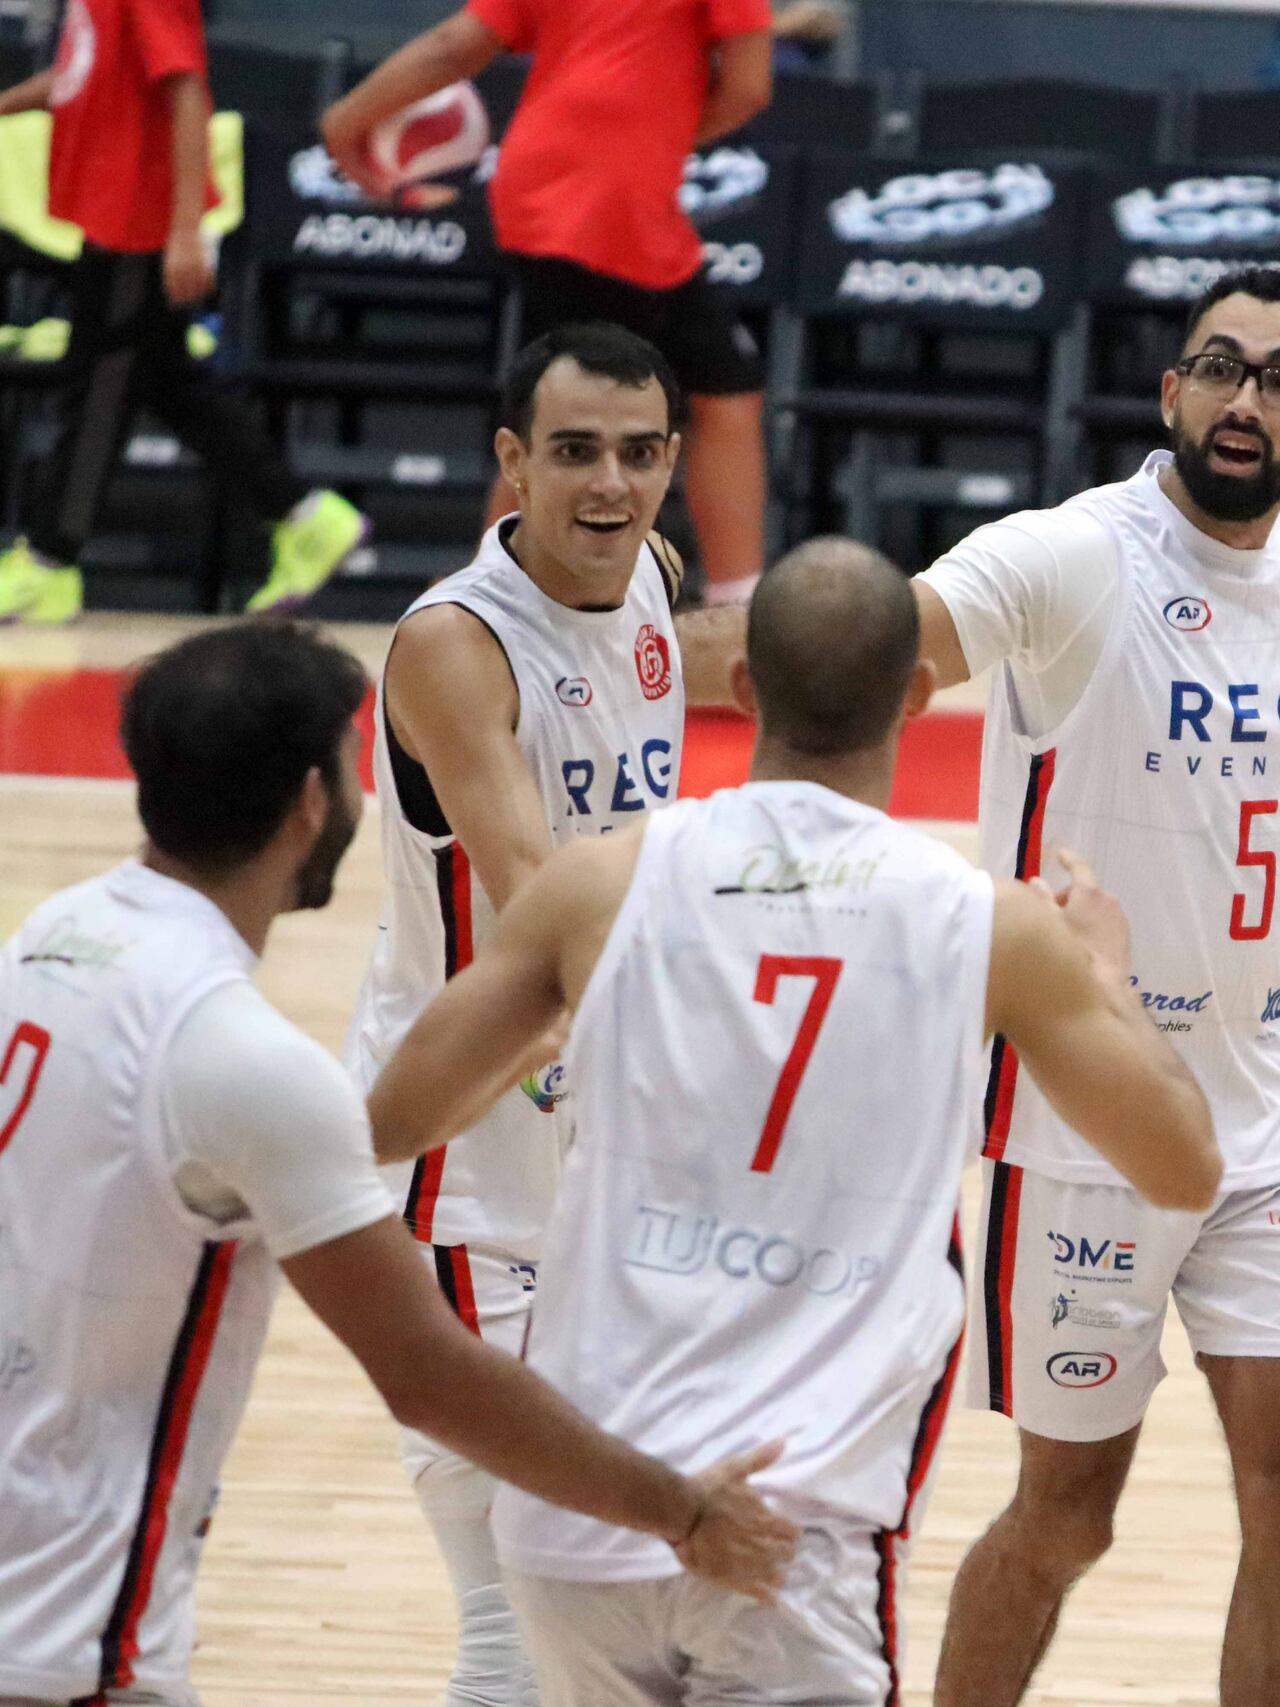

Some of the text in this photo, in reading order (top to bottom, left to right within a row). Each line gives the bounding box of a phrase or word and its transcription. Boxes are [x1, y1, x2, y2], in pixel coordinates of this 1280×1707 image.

[838, 259, 1043, 309] ABONADO
[1229, 800, 1278, 940] 5
[750, 953, 844, 1175] 7
[1060, 1360, 1101, 1377] AR
